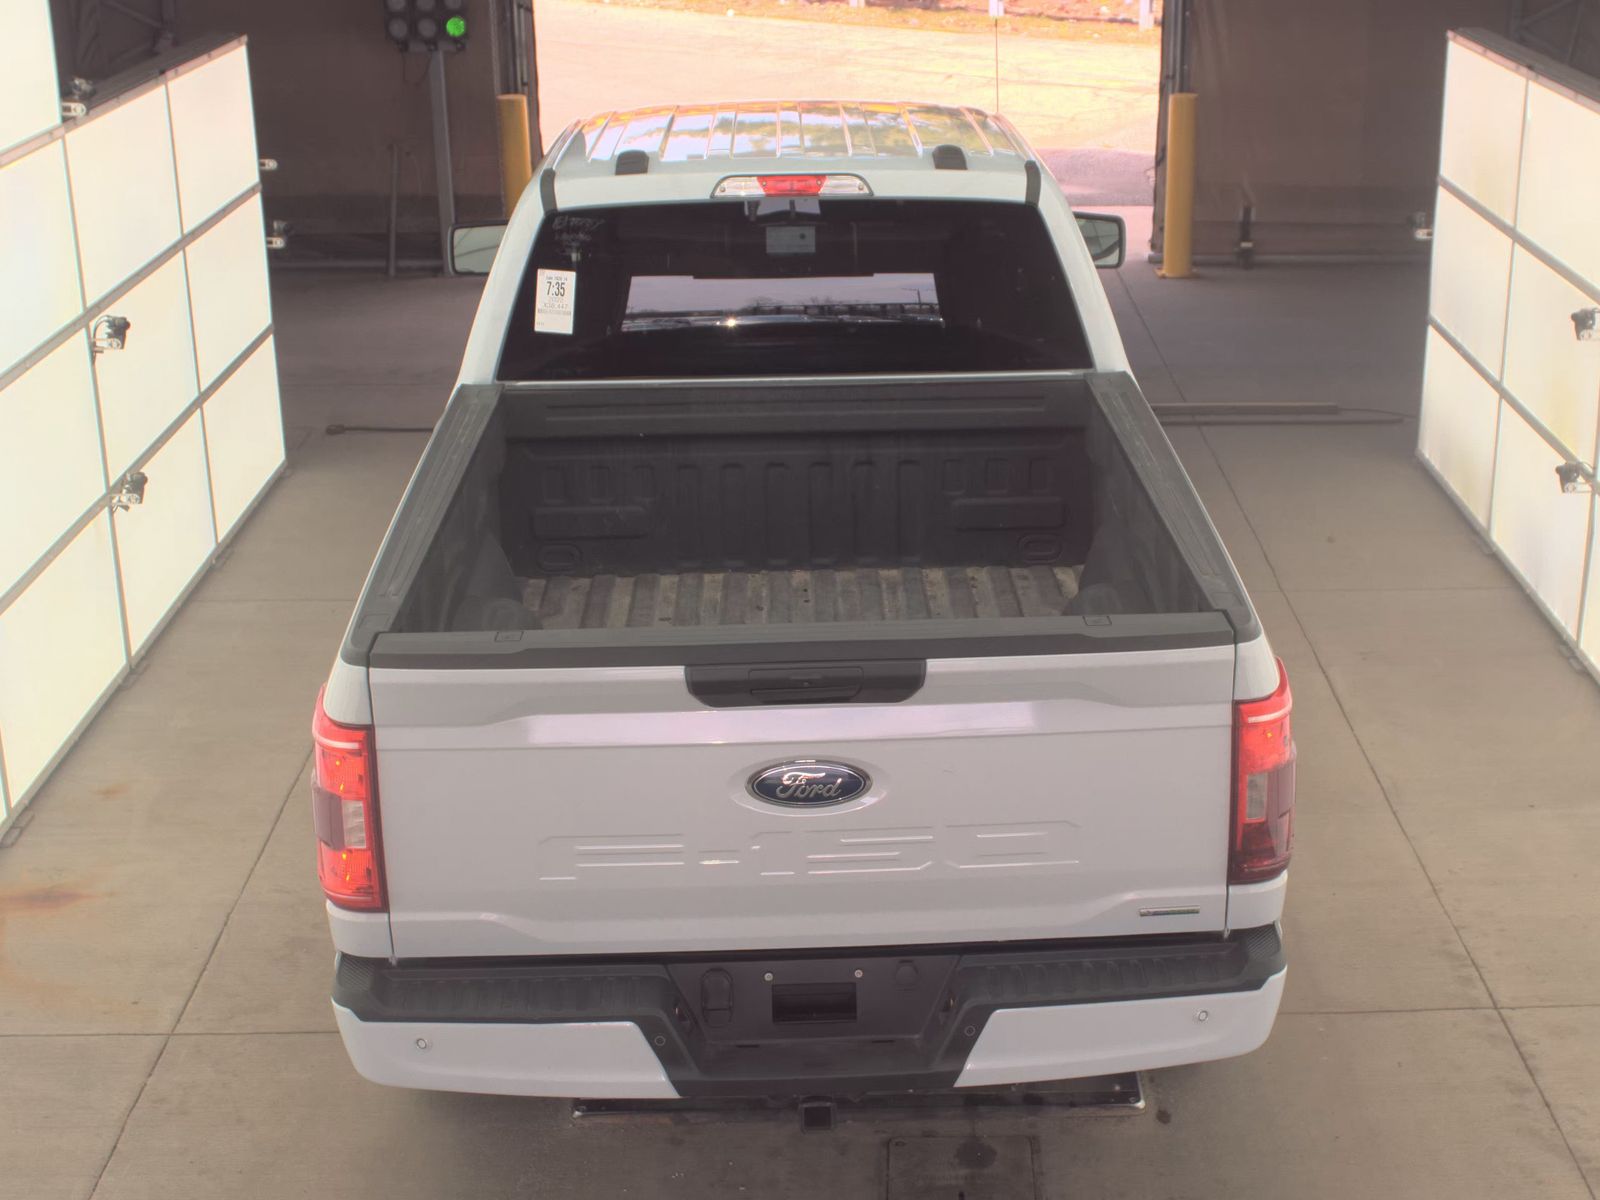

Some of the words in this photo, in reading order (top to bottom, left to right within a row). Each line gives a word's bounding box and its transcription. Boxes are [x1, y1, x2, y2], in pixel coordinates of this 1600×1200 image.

[546, 281, 566, 297] 7:35
[775, 771, 842, 798] Ford
[538, 821, 1080, 881] F-150
